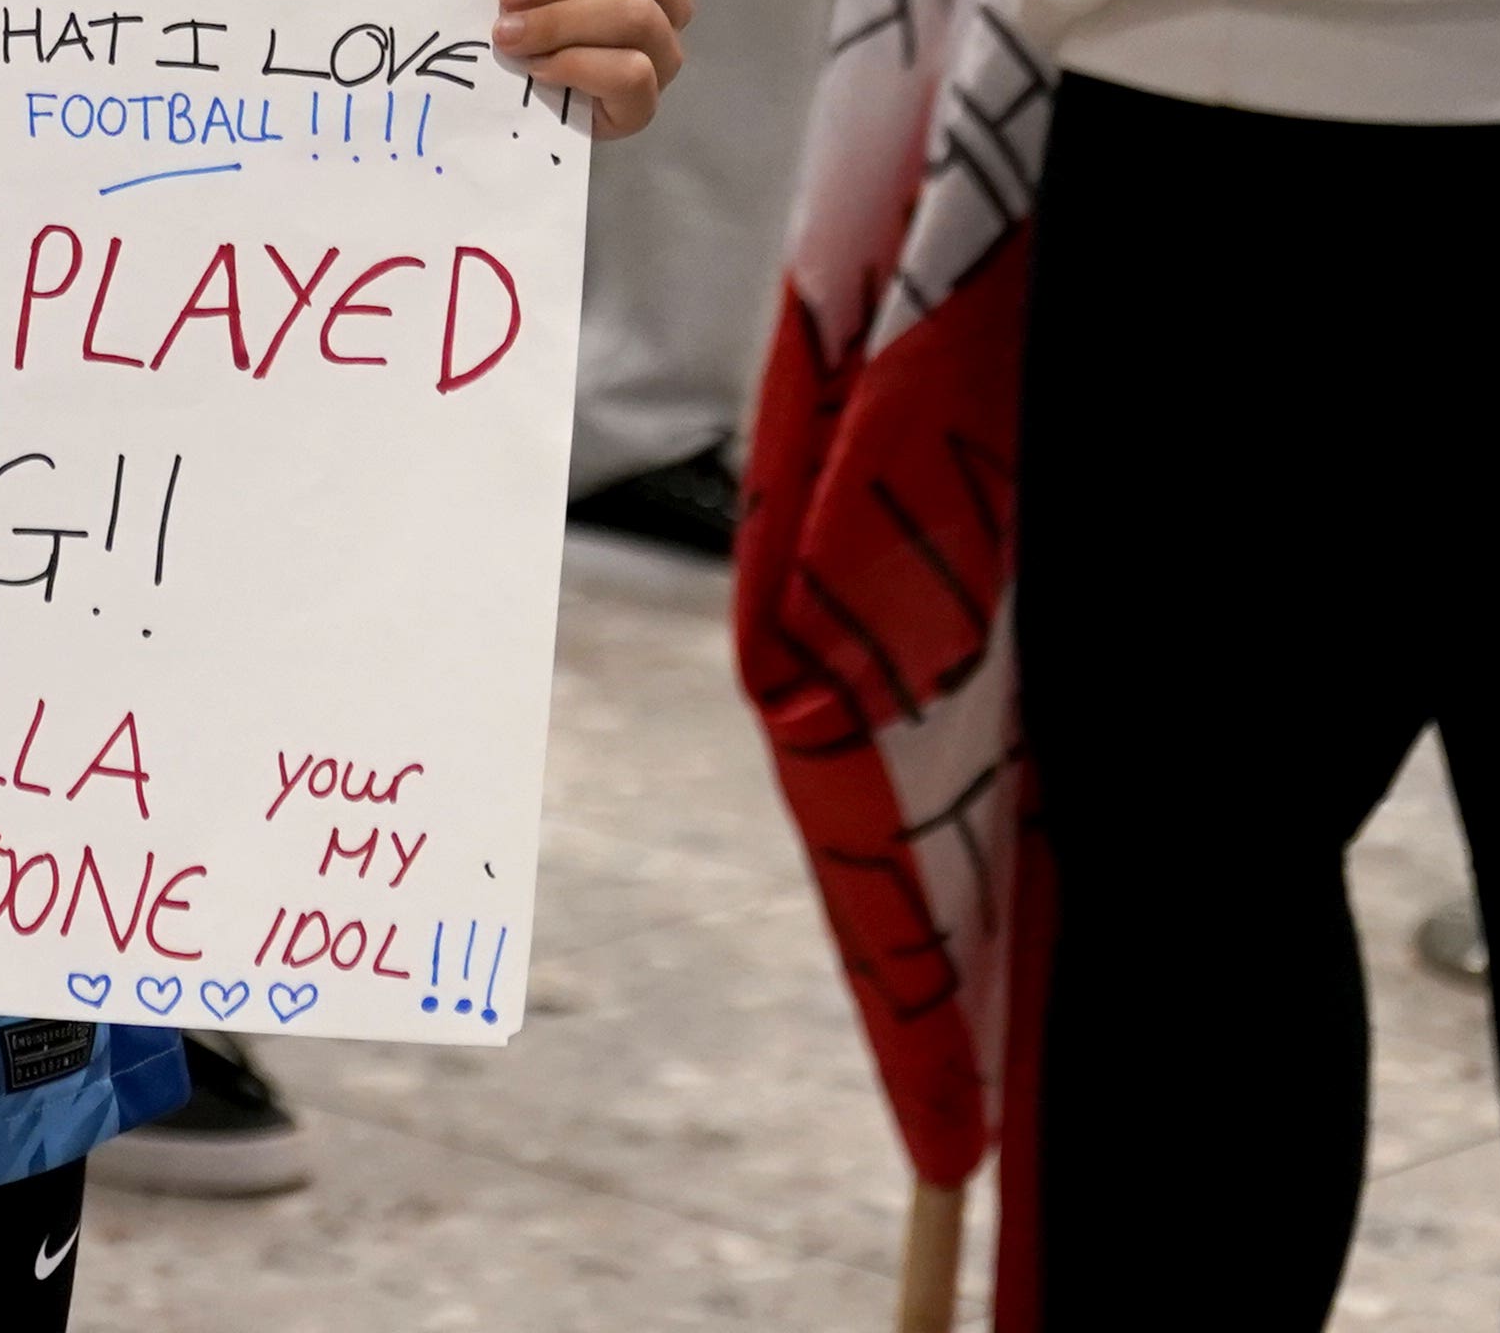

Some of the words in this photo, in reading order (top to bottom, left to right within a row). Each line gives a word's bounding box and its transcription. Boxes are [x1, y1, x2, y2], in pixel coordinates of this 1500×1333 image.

[154, 18, 228, 73] I
[13, 223, 522, 396] PLAYED
[265, 750, 425, 822] your
[317, 826, 428, 889] MY
